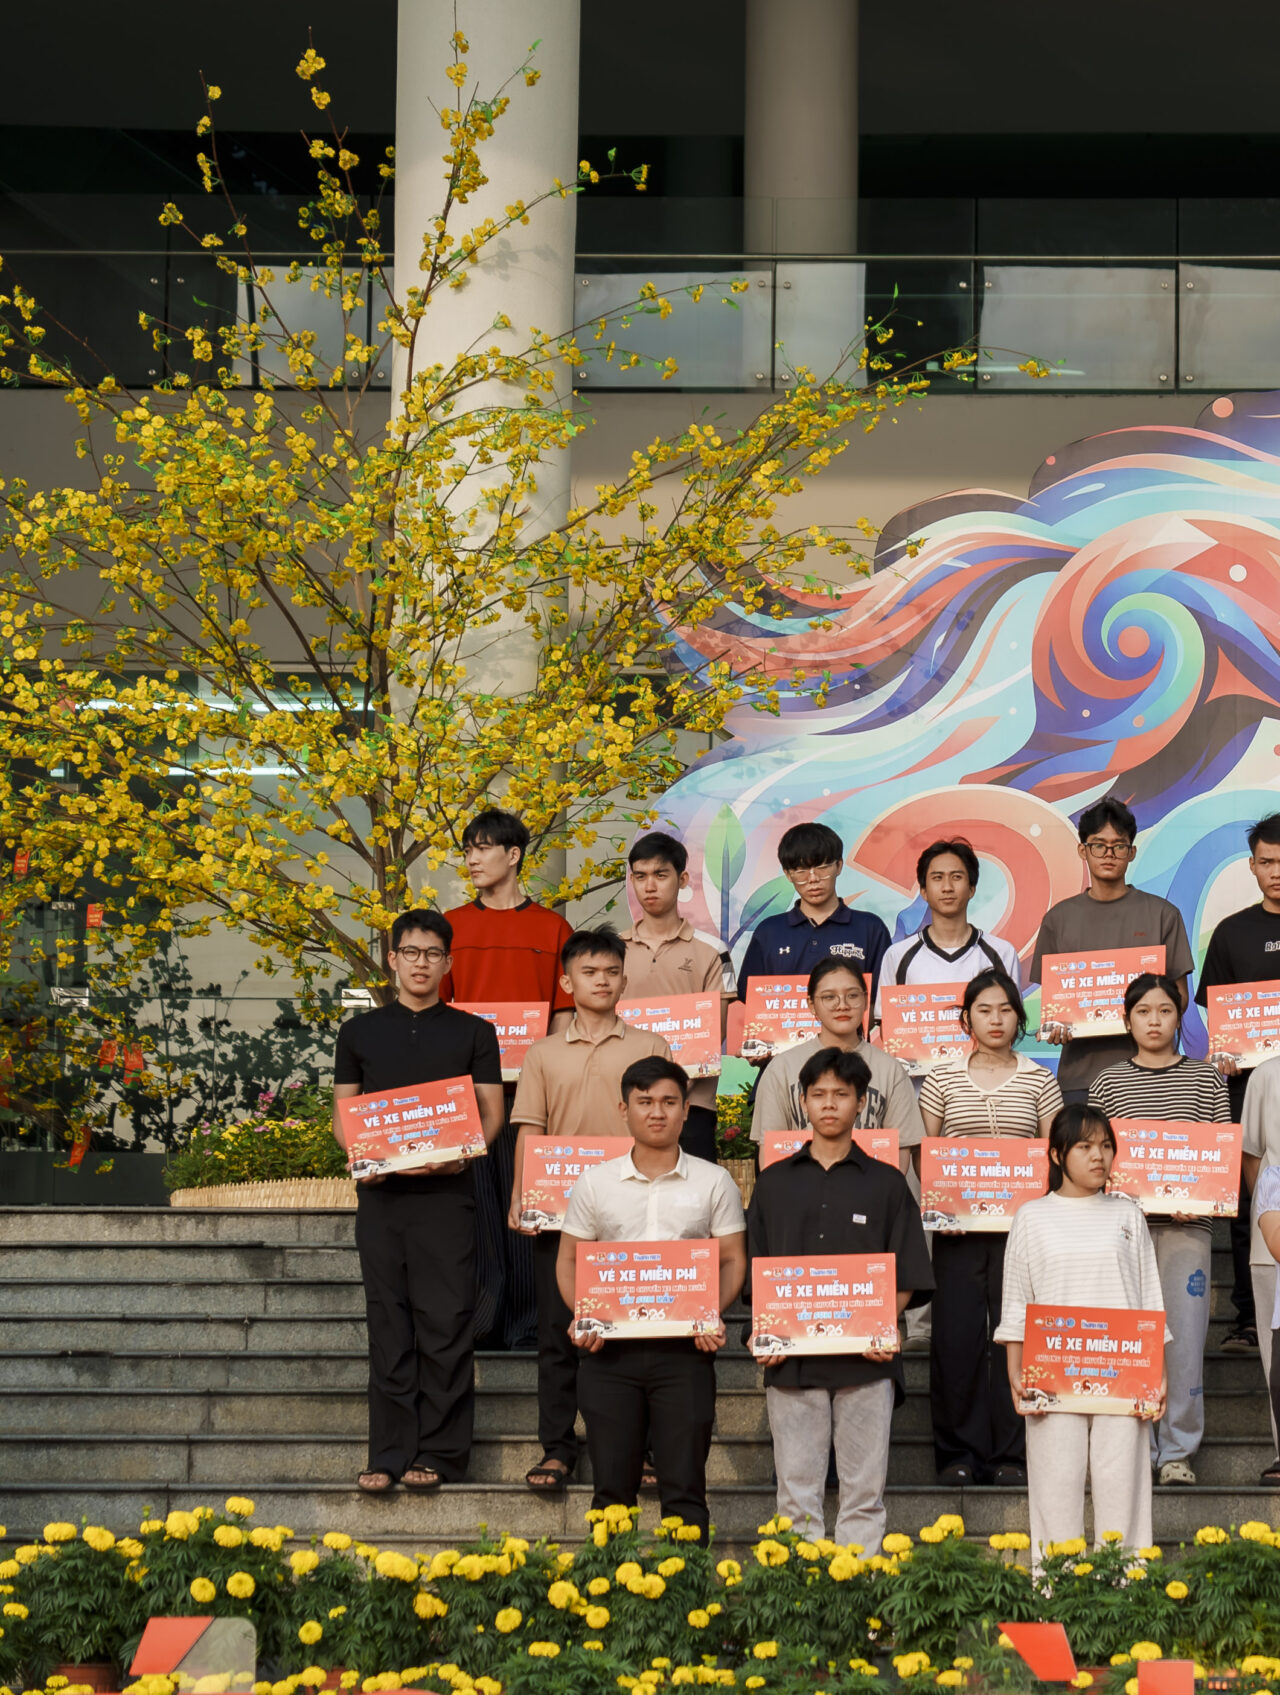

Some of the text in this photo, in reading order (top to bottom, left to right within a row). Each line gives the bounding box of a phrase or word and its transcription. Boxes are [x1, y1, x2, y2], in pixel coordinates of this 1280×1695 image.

[1061, 975, 1075, 988] VÉ
[1078, 976, 1093, 987] XE
[765, 997, 779, 1009] VÉ
[782, 999, 797, 1008] XE
[901, 1009, 916, 1022] VÉ
[919, 1010, 935, 1021] XE
[1227, 1006, 1242, 1019] VÉ
[1245, 1006, 1260, 1017] XE
[508, 1023, 527, 1035] PHÍ
[683, 1015, 701, 1029] PHÍ
[363, 1114, 380, 1128] VÉ
[382, 1112, 399, 1124] XE
[435, 1100, 456, 1114] PHÍ
[1129, 1144, 1144, 1157] VÉ
[1148, 1147, 1164, 1159] XE
[1201, 1148, 1220, 1161] PHÍ
[545, 1161, 560, 1174] VÉ
[564, 1164, 580, 1175] XE
[941, 1162, 957, 1176] VÉ
[961, 1165, 976, 1176] XE
[1013, 1163, 1033, 1177] PHÍ
[598, 1267, 614, 1282] VÉ
[619, 1269, 635, 1281] XE
[676, 1265, 696, 1279] PHÍ
[775, 1282, 791, 1297] VÉ
[796, 1285, 812, 1296] XE
[852, 1280, 873, 1295] PHÍ
[1046, 1334, 1062, 1349] VÉ
[1065, 1337, 1082, 1350] XE
[1121, 1338, 1141, 1353] PHÍ
